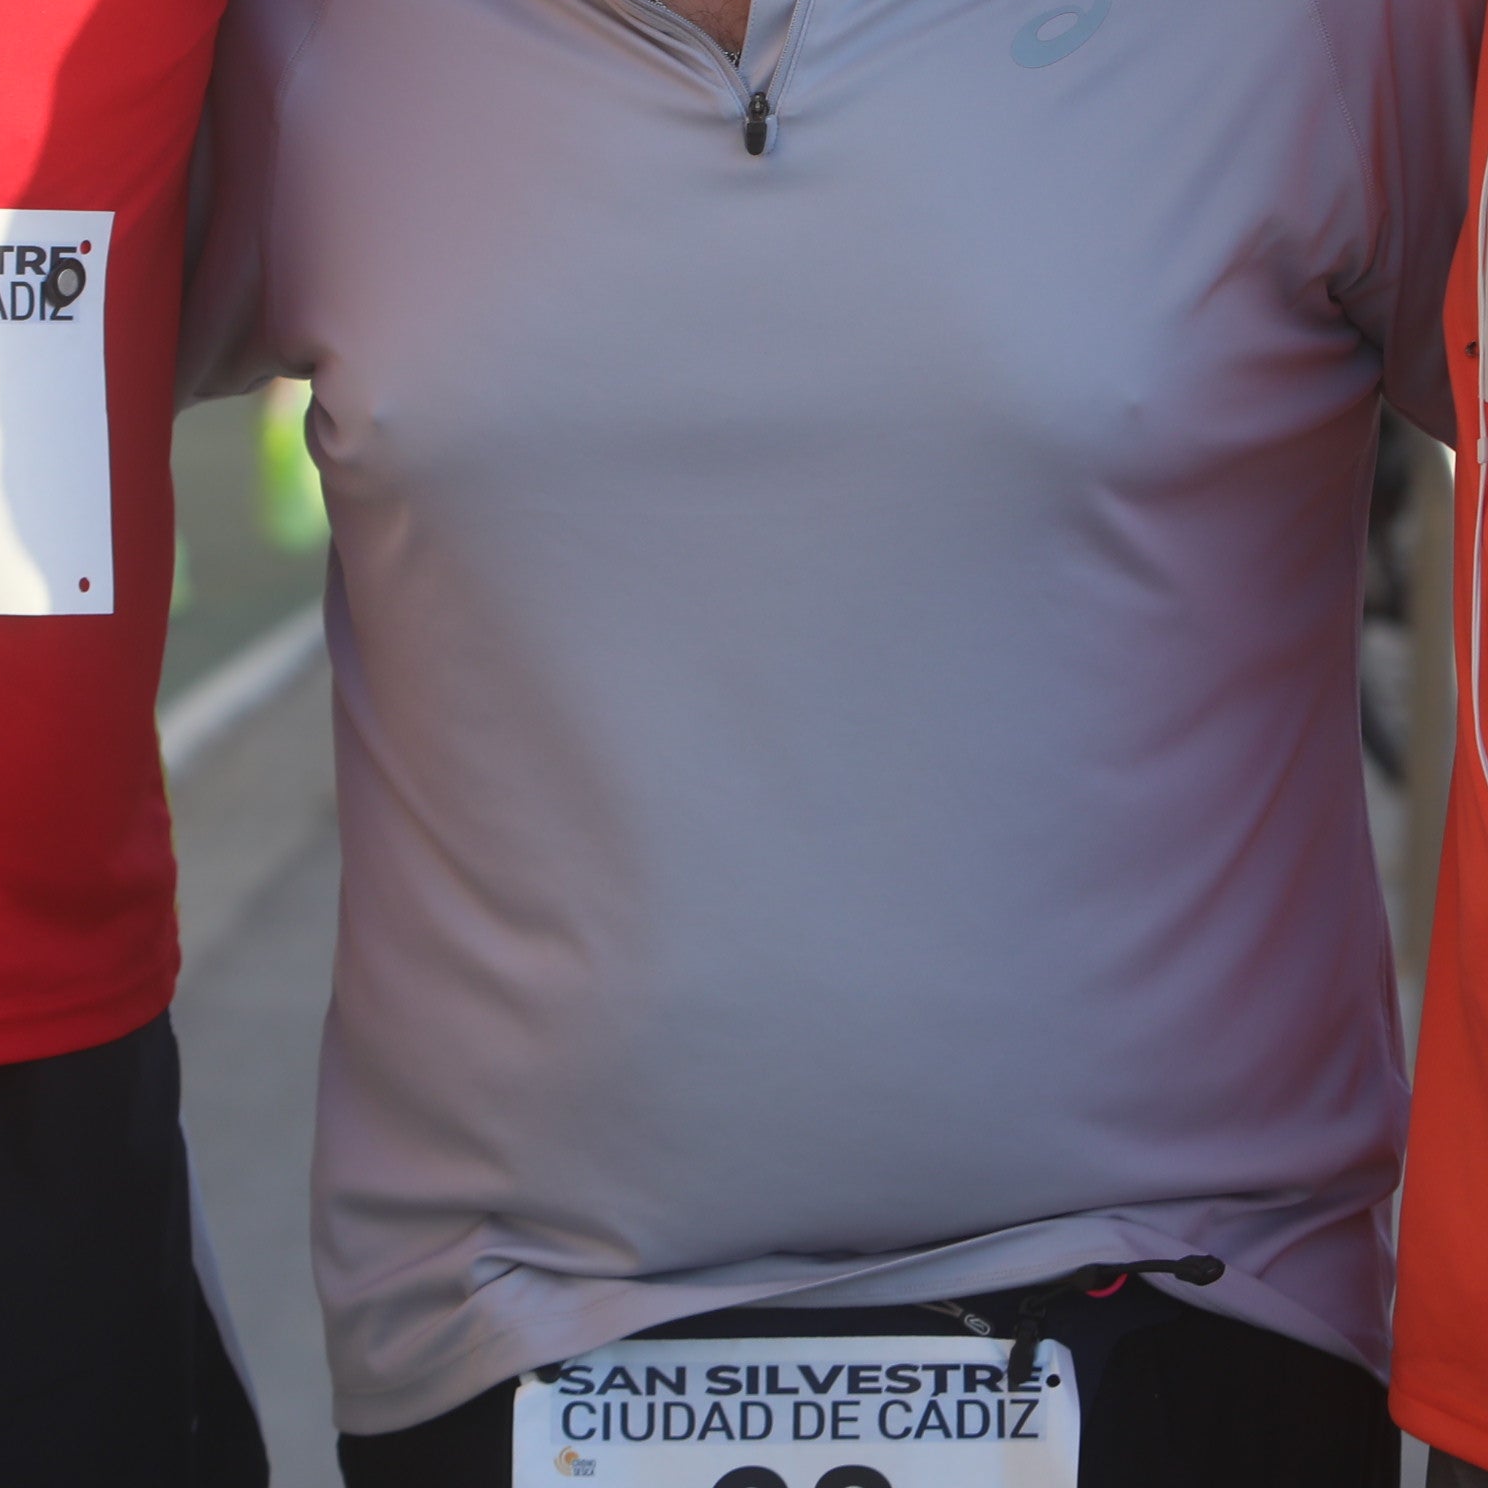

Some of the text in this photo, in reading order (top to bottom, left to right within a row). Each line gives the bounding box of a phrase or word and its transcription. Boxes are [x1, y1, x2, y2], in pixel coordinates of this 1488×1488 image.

[558, 1364, 1043, 1396] SAN SILVESTRE
[562, 1394, 1040, 1442] CIUDAD DE CÁDIZ
